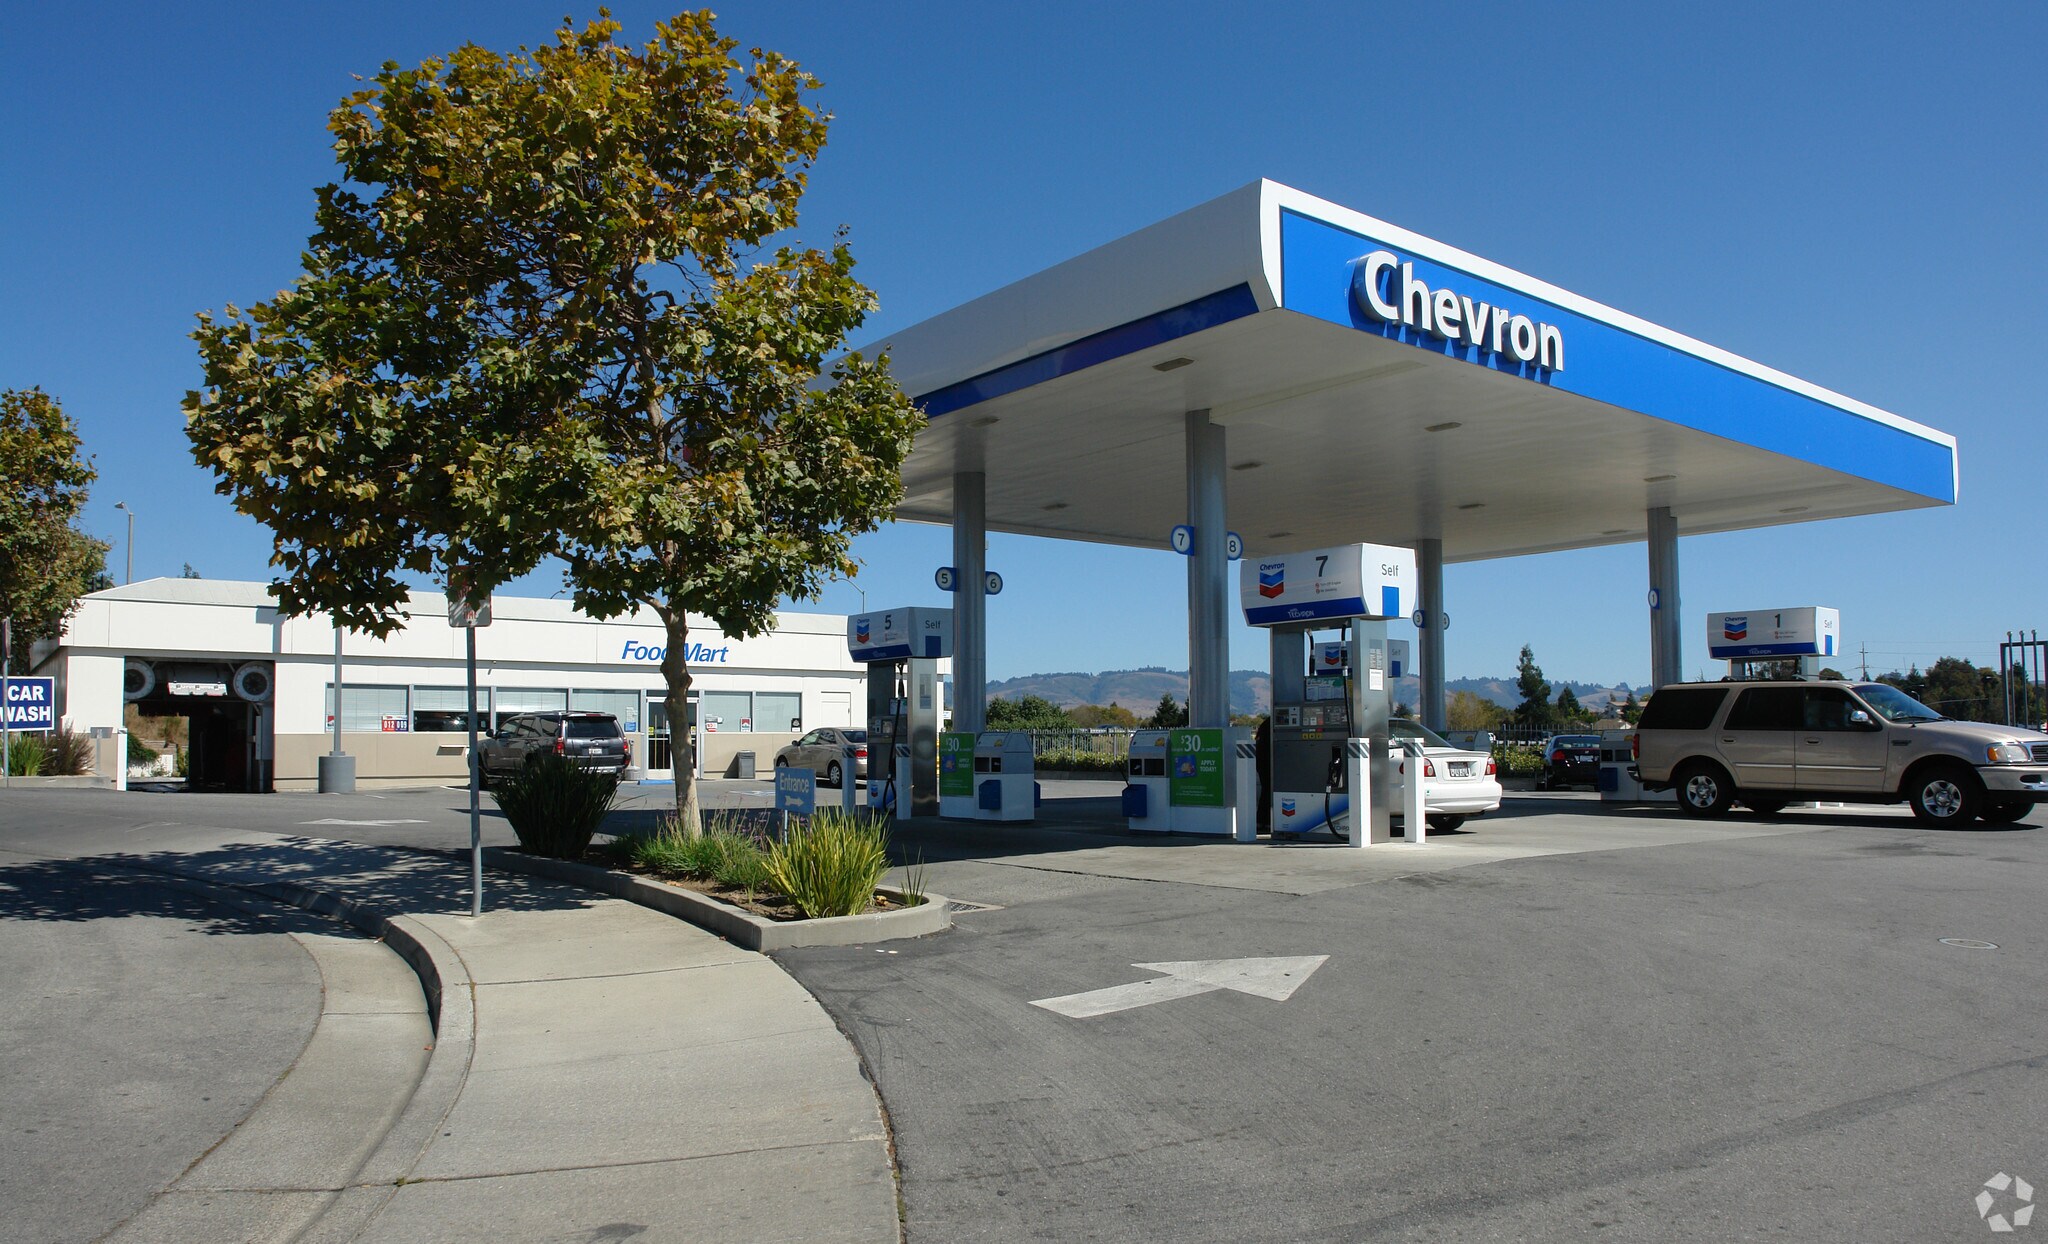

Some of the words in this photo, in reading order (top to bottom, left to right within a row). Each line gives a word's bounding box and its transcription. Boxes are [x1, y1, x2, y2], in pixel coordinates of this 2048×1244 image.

[1359, 250, 1564, 372] Chevron
[1178, 533, 1185, 546] 7
[1229, 540, 1237, 553] 8
[1259, 562, 1285, 571] Chevron
[1315, 555, 1329, 578] 7
[1381, 563, 1399, 577] Self
[941, 573, 949, 584] 5
[990, 578, 997, 589] 6
[884, 614, 892, 630] 5
[925, 620, 941, 629] Self
[1774, 613, 1781, 628] 1
[8, 685, 45, 701] CAR
[0, 705, 51, 722] WASH
[1181, 734, 1202, 752] $30
[780, 772, 810, 793] Entrance
